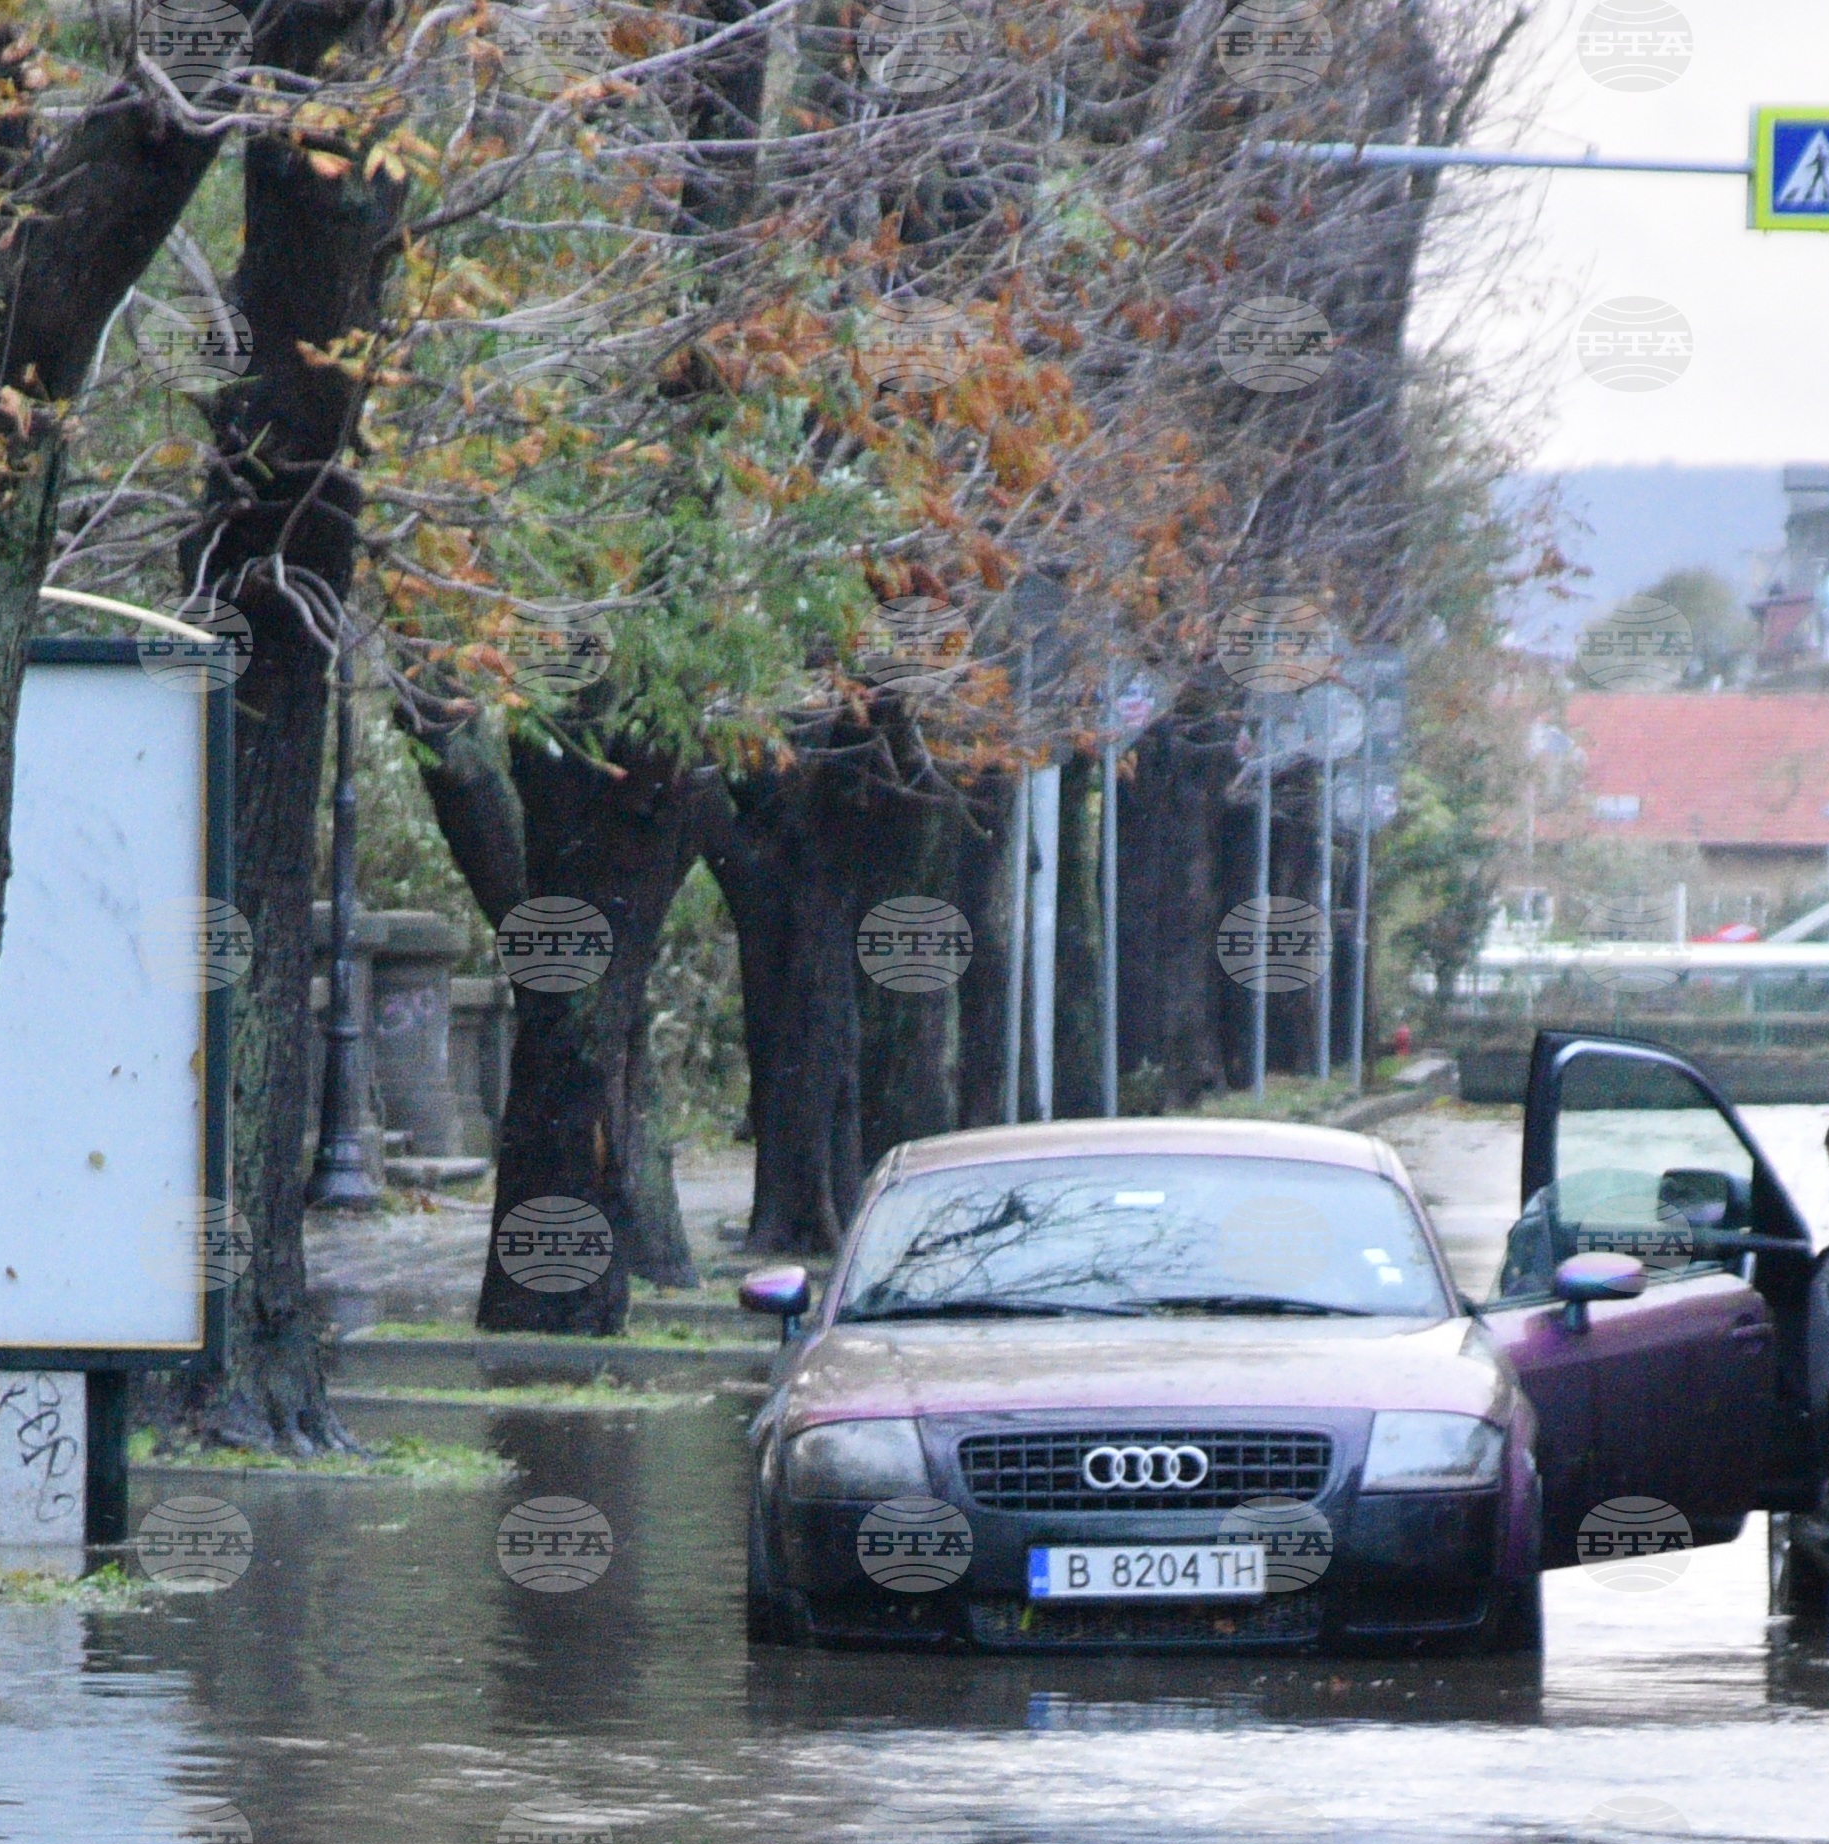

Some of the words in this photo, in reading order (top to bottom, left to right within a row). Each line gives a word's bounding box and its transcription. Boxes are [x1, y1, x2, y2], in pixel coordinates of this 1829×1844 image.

[1067, 1553, 1091, 1589] B
[1111, 1551, 1200, 1588] 8204
[1210, 1550, 1258, 1586] TH
